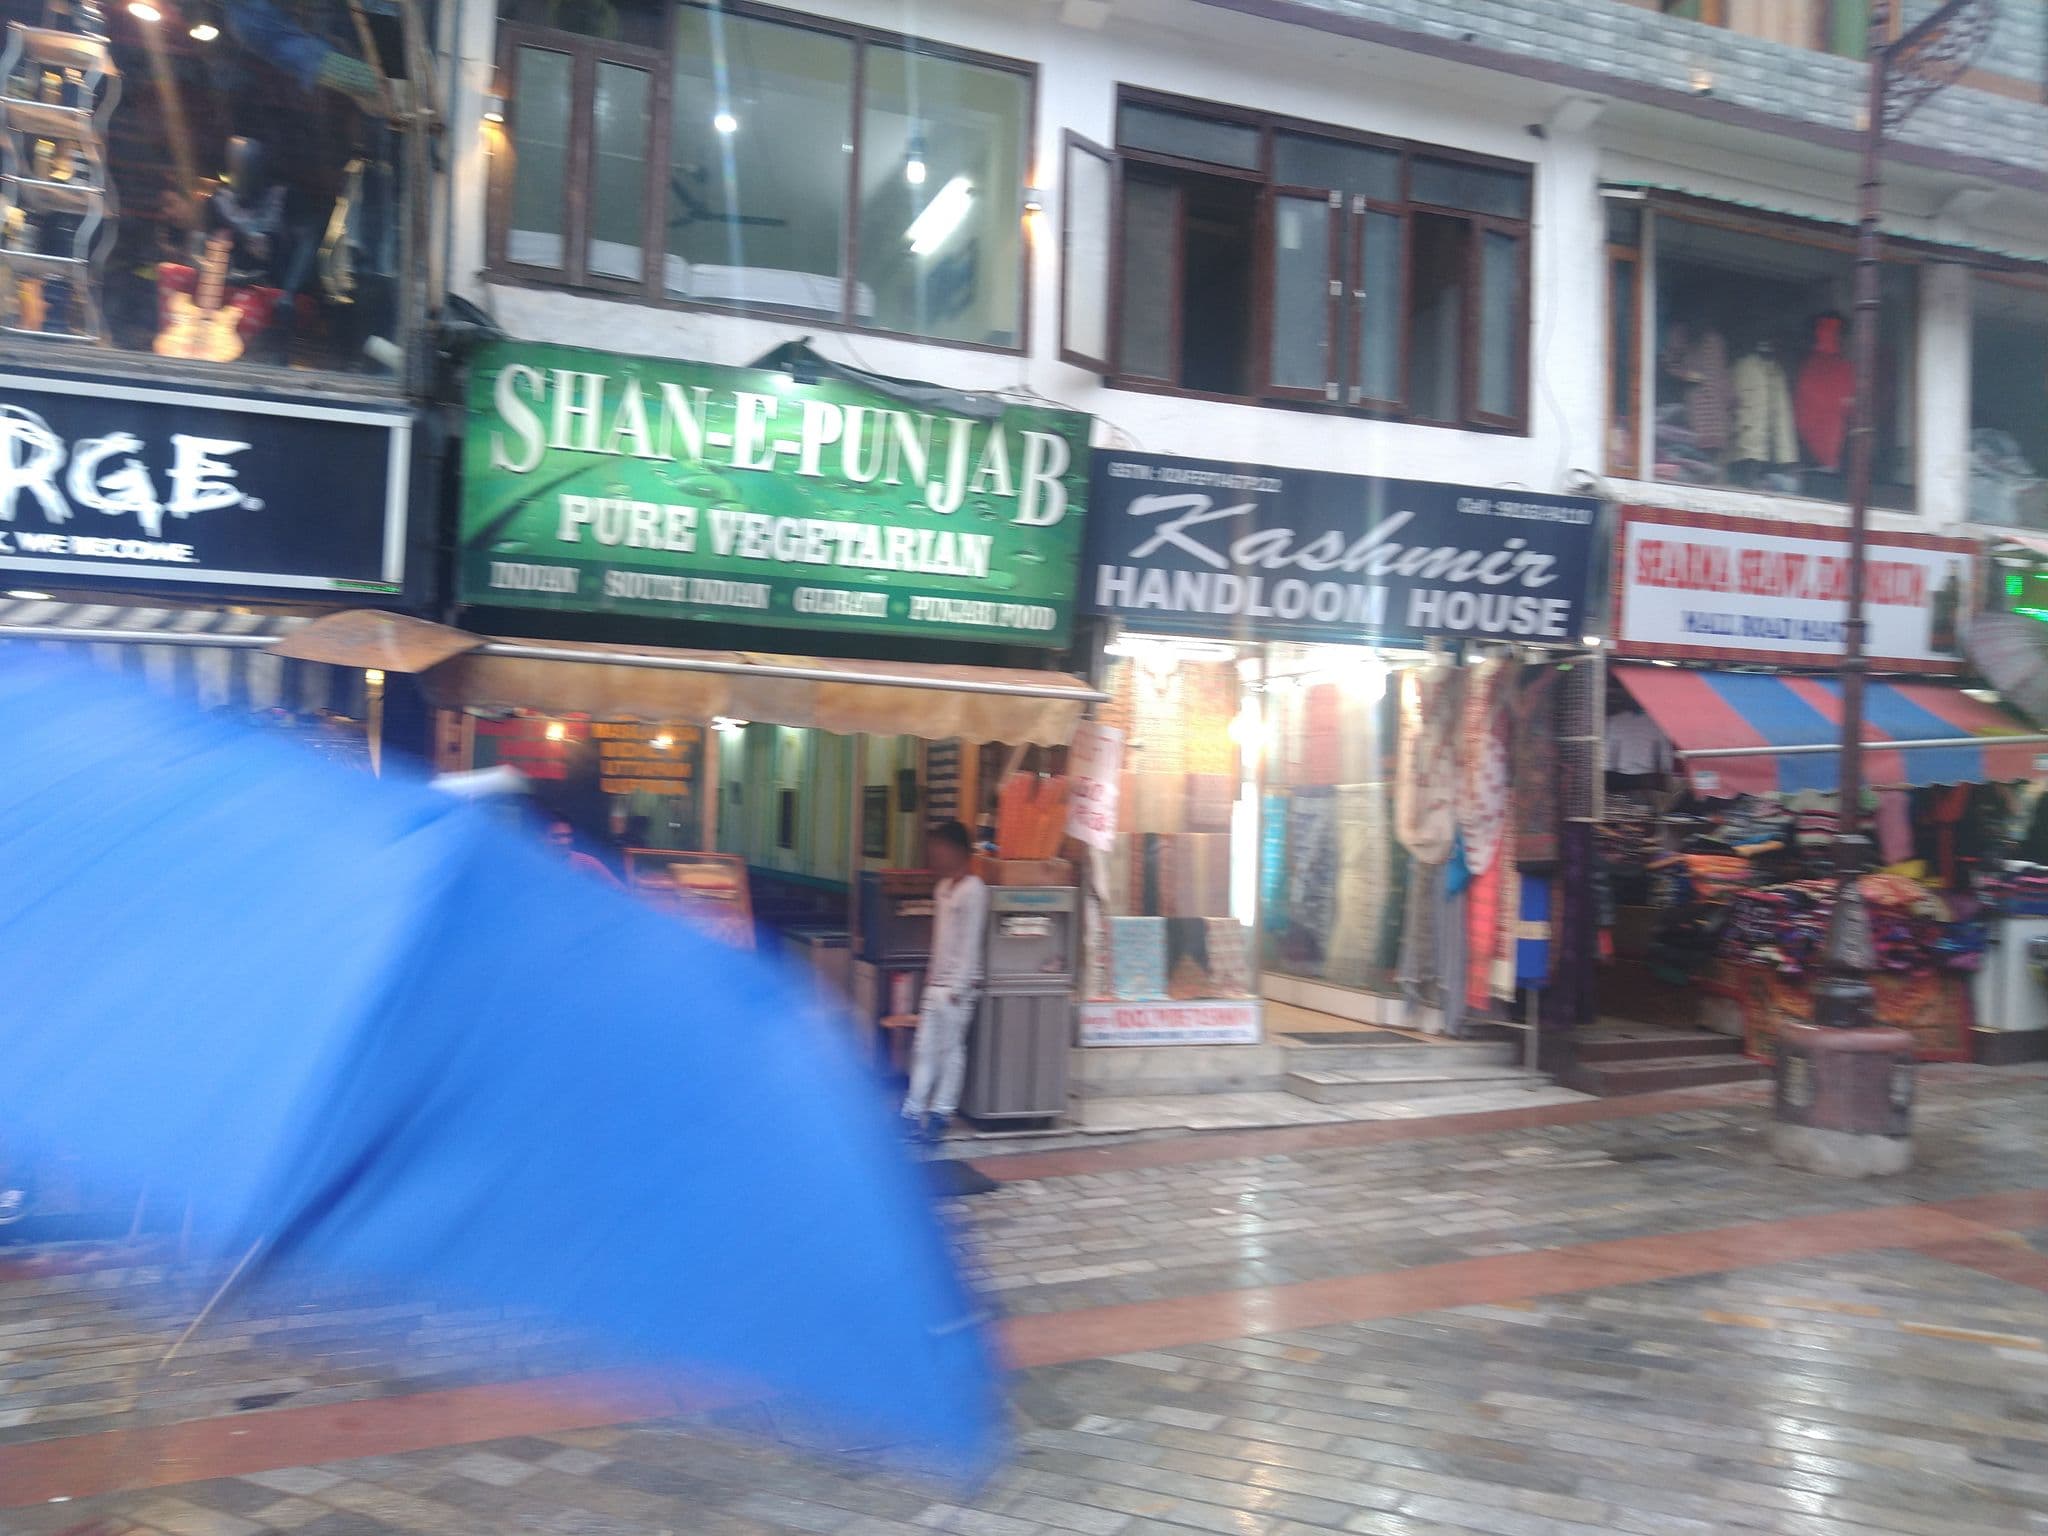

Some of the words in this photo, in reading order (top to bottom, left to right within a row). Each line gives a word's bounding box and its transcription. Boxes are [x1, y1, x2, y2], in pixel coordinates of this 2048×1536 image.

[557, 494, 696, 553] PURE
[706, 509, 995, 578] VEGETARIAN
[1125, 493, 1560, 588] Kashmir
[604, 569, 686, 602] SOUTH
[687, 577, 772, 609] INDIAN
[1095, 563, 1391, 626] HANDLOOM
[1405, 587, 1573, 637] HOUSE
